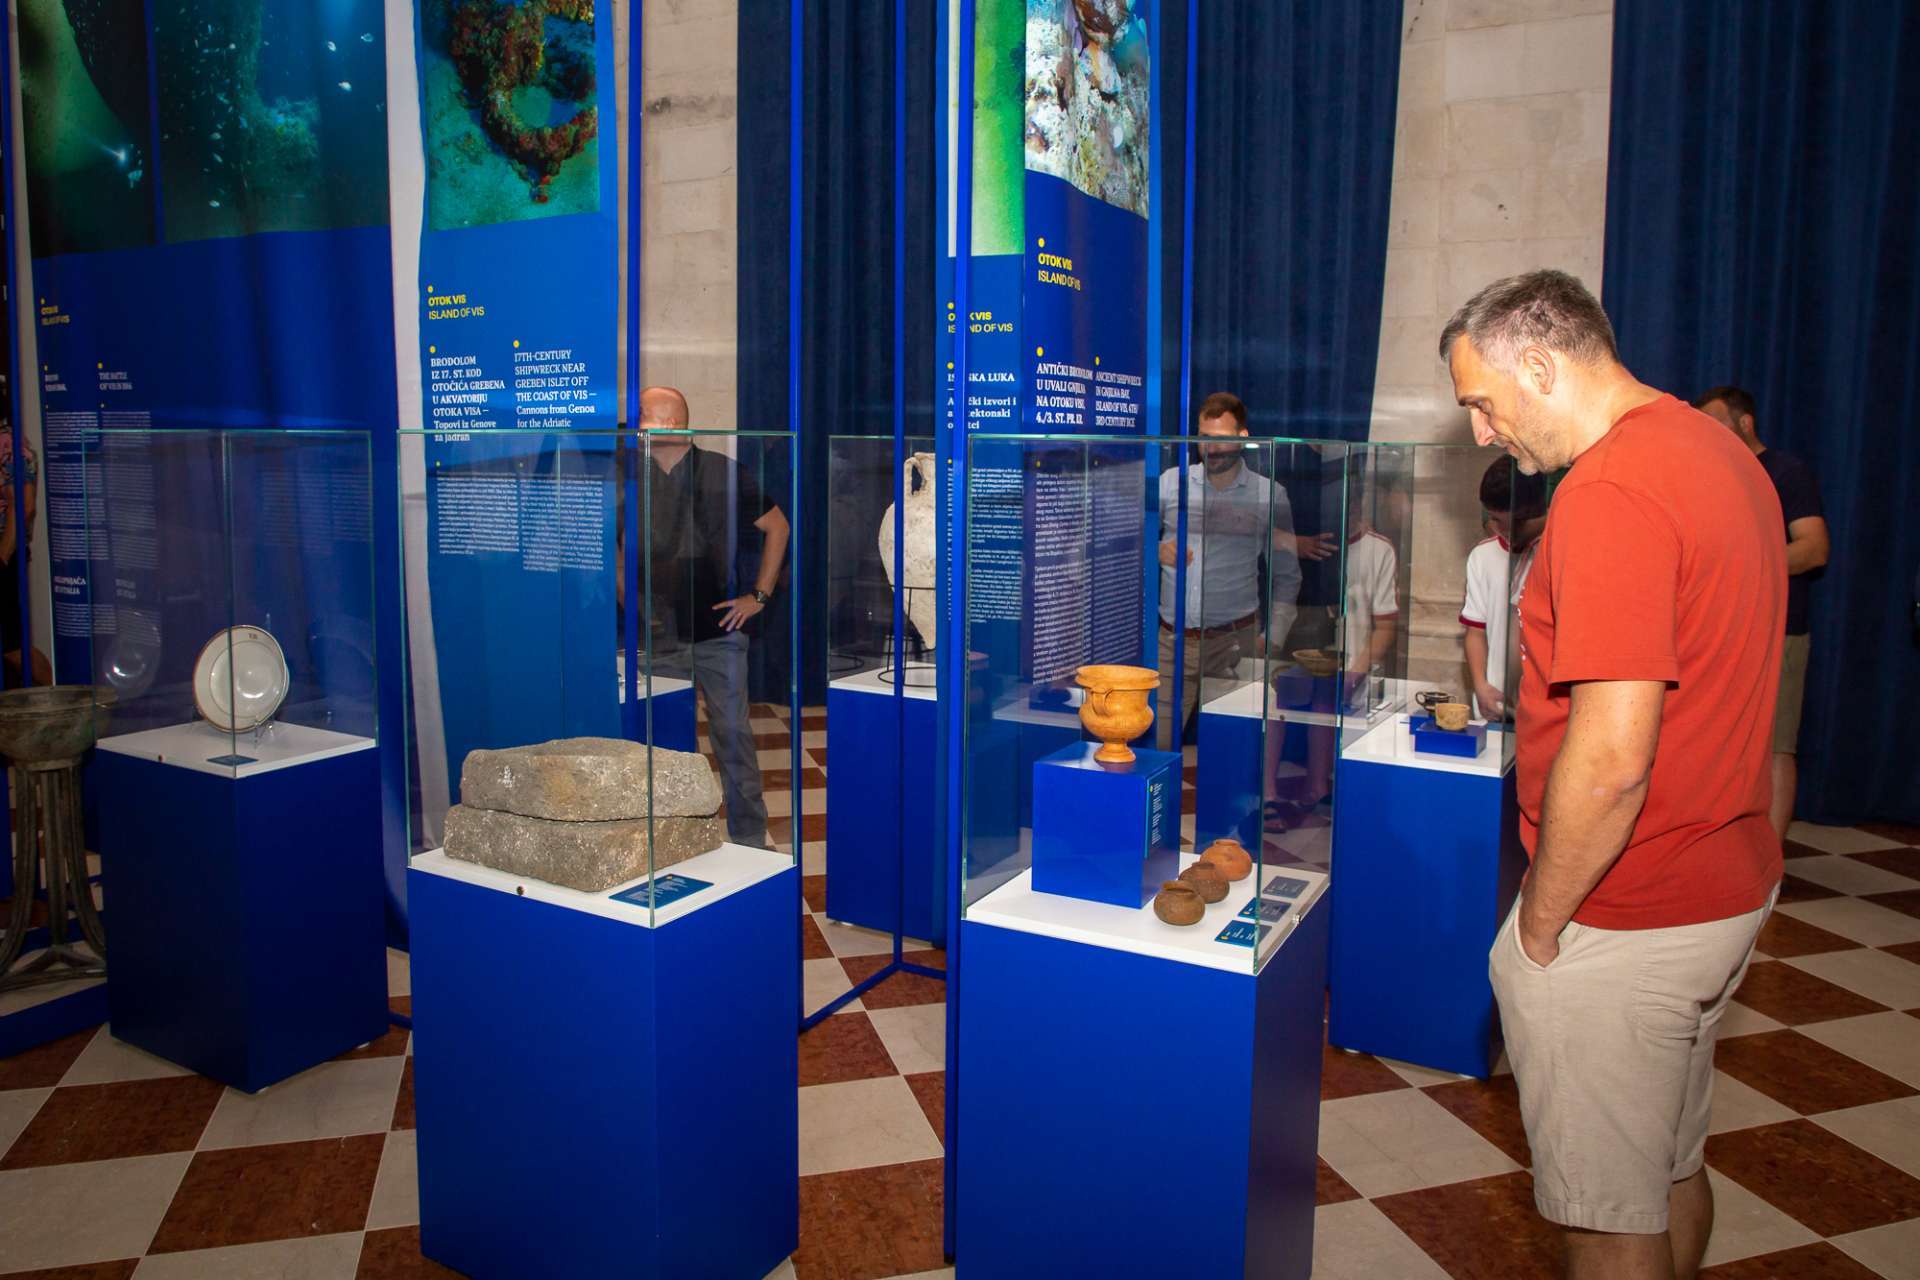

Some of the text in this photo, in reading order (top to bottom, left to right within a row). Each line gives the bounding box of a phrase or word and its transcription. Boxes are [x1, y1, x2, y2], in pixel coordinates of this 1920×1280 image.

[1038, 253, 1073, 270] OTOK VIS
[1038, 269, 1066, 285] ISLAND
[428, 294, 467, 307] OTOK VIS
[428, 306, 485, 320] ISLAND OF VIS
[975, 311, 992, 321] VIS
[983, 323, 997, 332] OF
[997, 322, 1013, 333] VIS
[430, 355, 476, 367] BRODOLOM
[514, 349, 572, 363] 17TH-CENTURY
[431, 368, 482, 380] IZ 17. ST. KOD
[514, 362, 586, 376] SHIPWRECK NEAR
[1036, 361, 1069, 376] ANTIČKI
[515, 376, 589, 389] GREBEN ISLET OFF
[988, 372, 1015, 382] LUKA
[432, 380, 506, 392] OTOČIĆA GREBENA
[1036, 378, 1043, 391] U
[1044, 379, 1067, 392] UVALI
[432, 393, 488, 405] U AKVATORIJU
[515, 391, 532, 402] THE
[532, 390, 560, 401] COAST
[560, 390, 572, 401] OF
[573, 389, 588, 400] VIS
[983, 396, 1011, 406] izvori
[1036, 395, 1049, 407] NA
[1049, 396, 1074, 408] OTOKU
[433, 407, 462, 417] OTOKA
[464, 406, 482, 416] VISA
[516, 403, 595, 415] Cannons from Genoa
[517, 417, 572, 428] for the Adriatic
[1035, 411, 1054, 424] 4./3.
[1055, 412, 1066, 424] ST.
[434, 419, 497, 430] Topovi iz Genove
[434, 434, 444, 442] za
